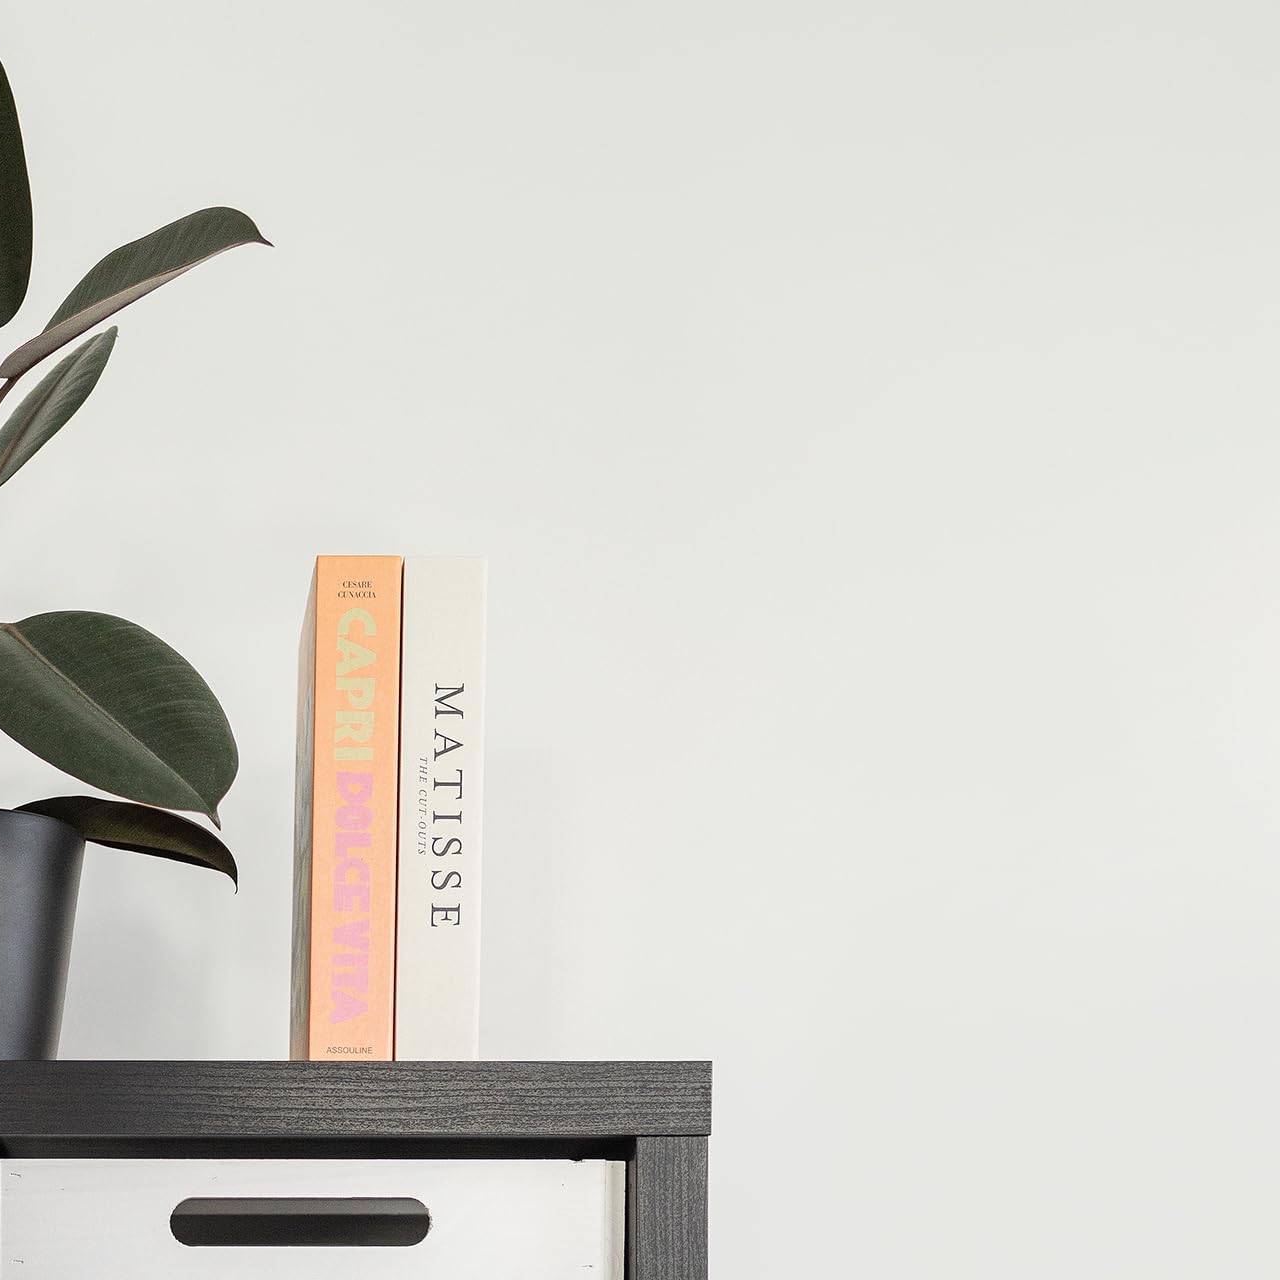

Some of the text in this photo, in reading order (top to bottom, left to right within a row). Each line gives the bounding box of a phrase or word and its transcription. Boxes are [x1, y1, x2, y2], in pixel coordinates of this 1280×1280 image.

[337, 591, 376, 599] CUNACCIA
[342, 580, 372, 588] CESARE
[331, 607, 377, 1024] CAPRI DOLCE VITA
[417, 757, 428, 855] THE CUT-OUTS
[430, 683, 465, 927] MATISSE
[326, 1046, 373, 1054] ASSOULINE
